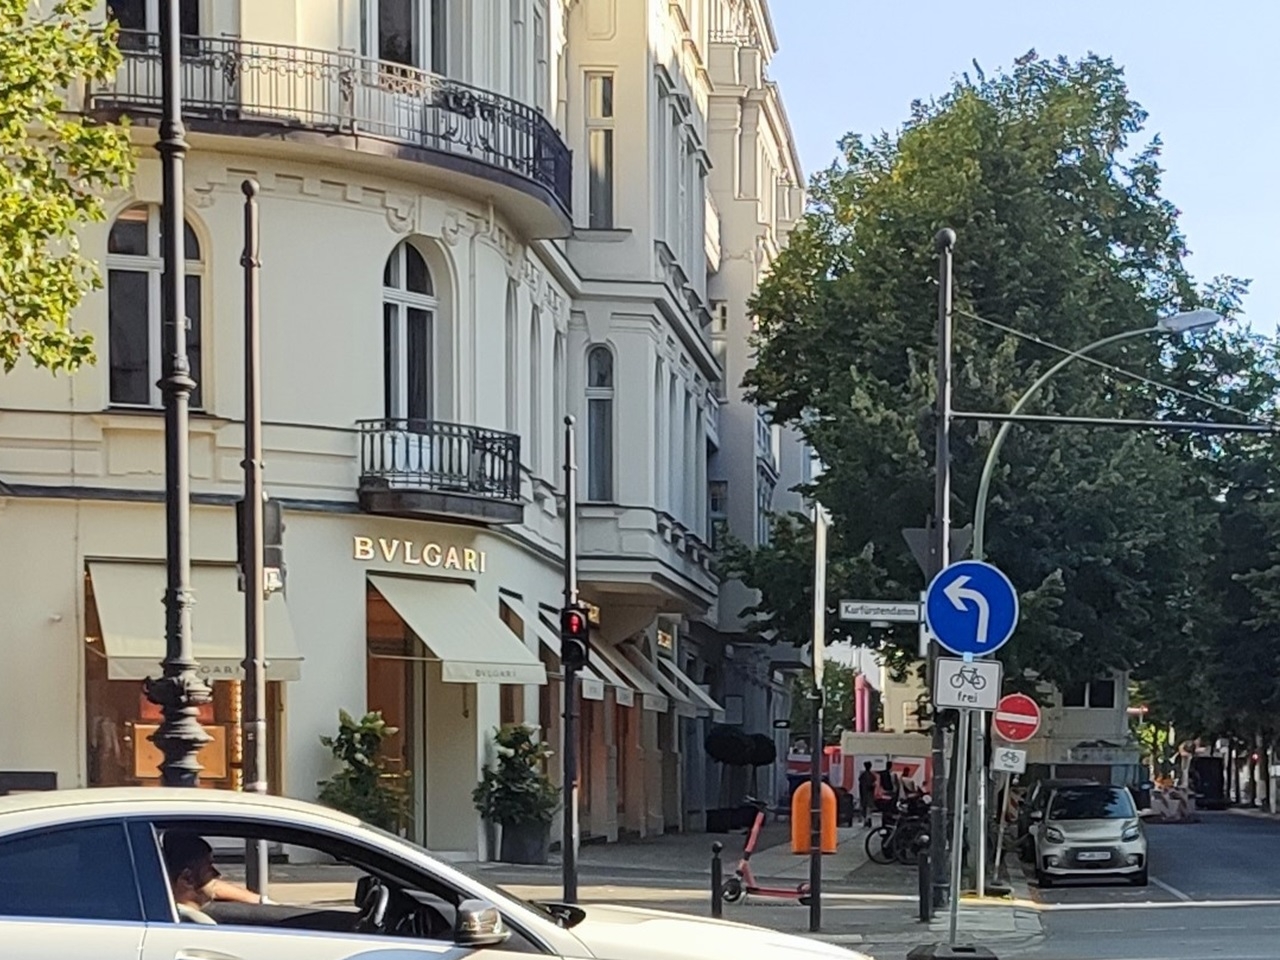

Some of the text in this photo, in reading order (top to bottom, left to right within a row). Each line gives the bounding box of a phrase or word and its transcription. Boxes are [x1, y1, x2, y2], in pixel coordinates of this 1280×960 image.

[353, 535, 487, 573] BVLGARI
[844, 604, 916, 616] Kurfürstendamm
[200, 665, 240, 674] GARI
[475, 668, 517, 679] BVLGARI
[957, 690, 978, 703] frei
